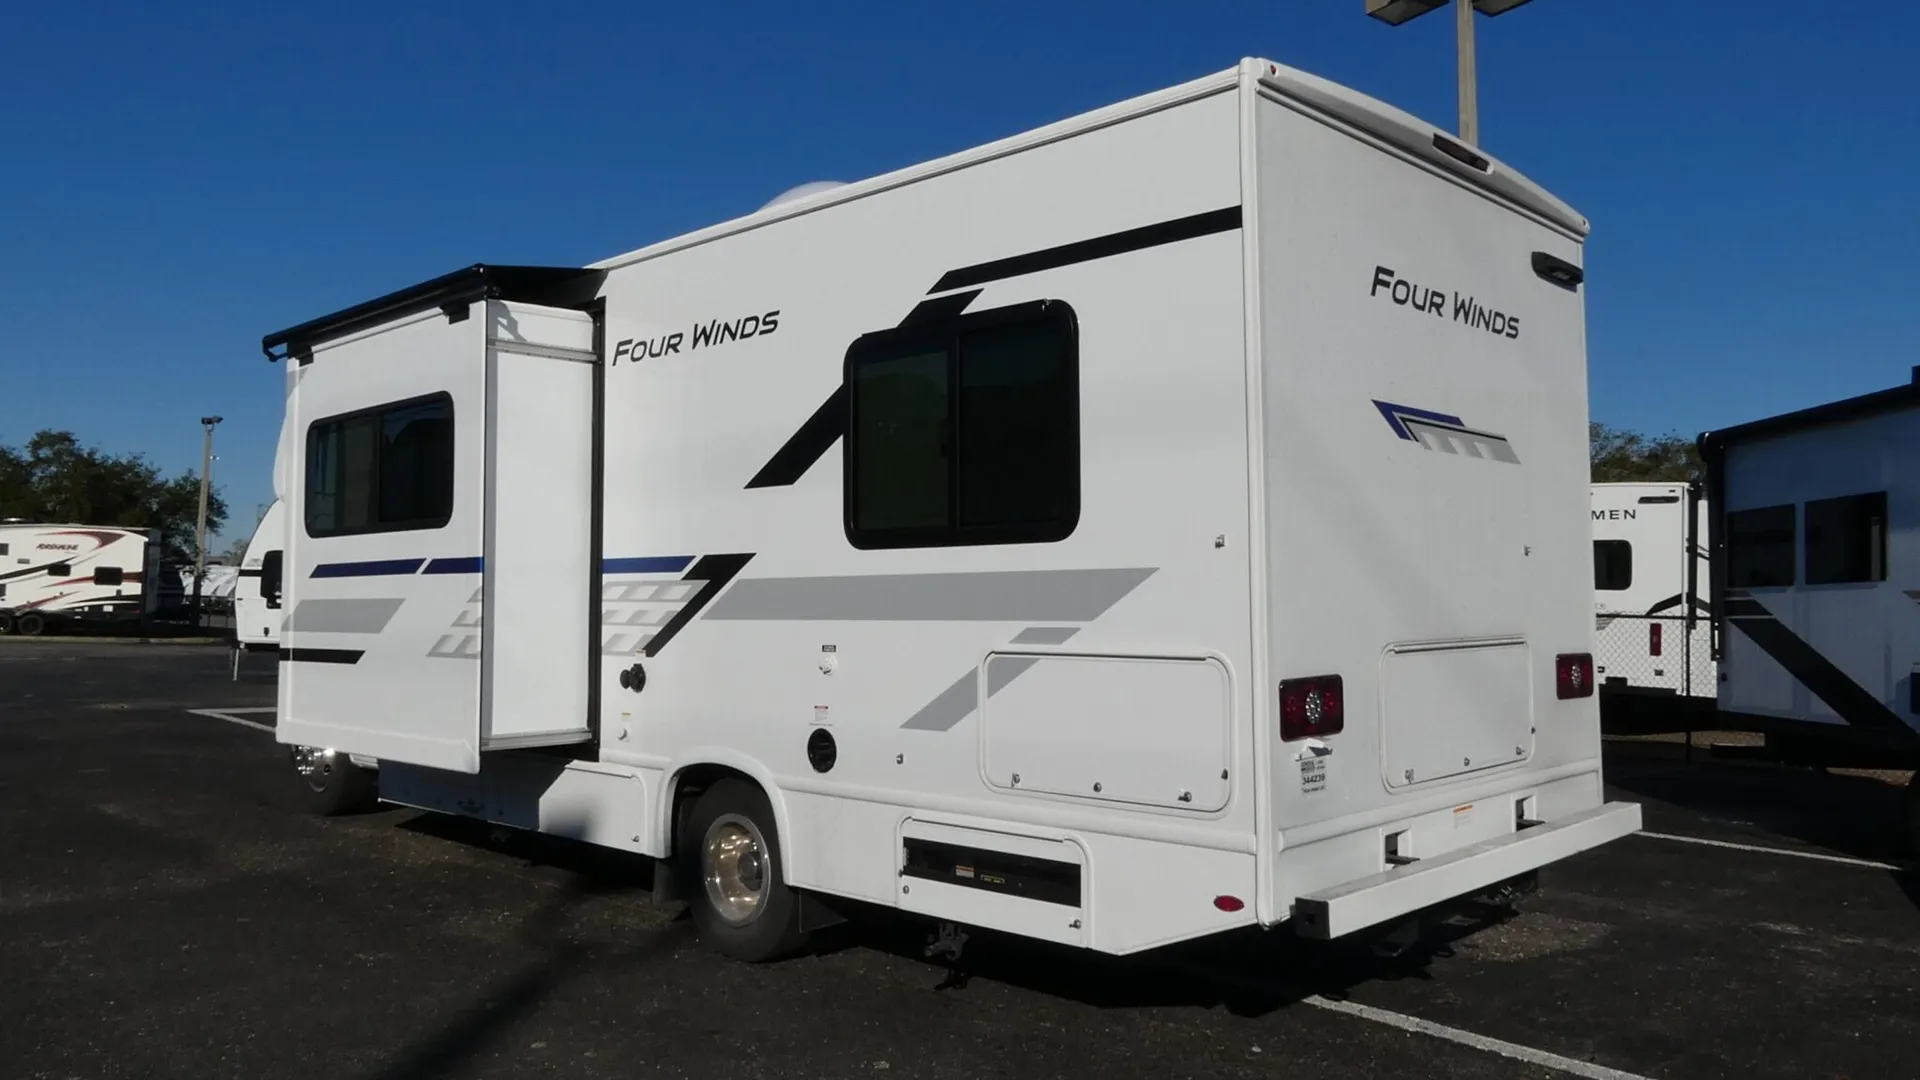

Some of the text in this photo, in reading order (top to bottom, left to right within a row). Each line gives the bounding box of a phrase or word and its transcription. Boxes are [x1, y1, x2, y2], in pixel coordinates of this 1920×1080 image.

[1370, 265, 1520, 340] FOUR WINDS
[612, 309, 781, 367] FOUR WINDS
